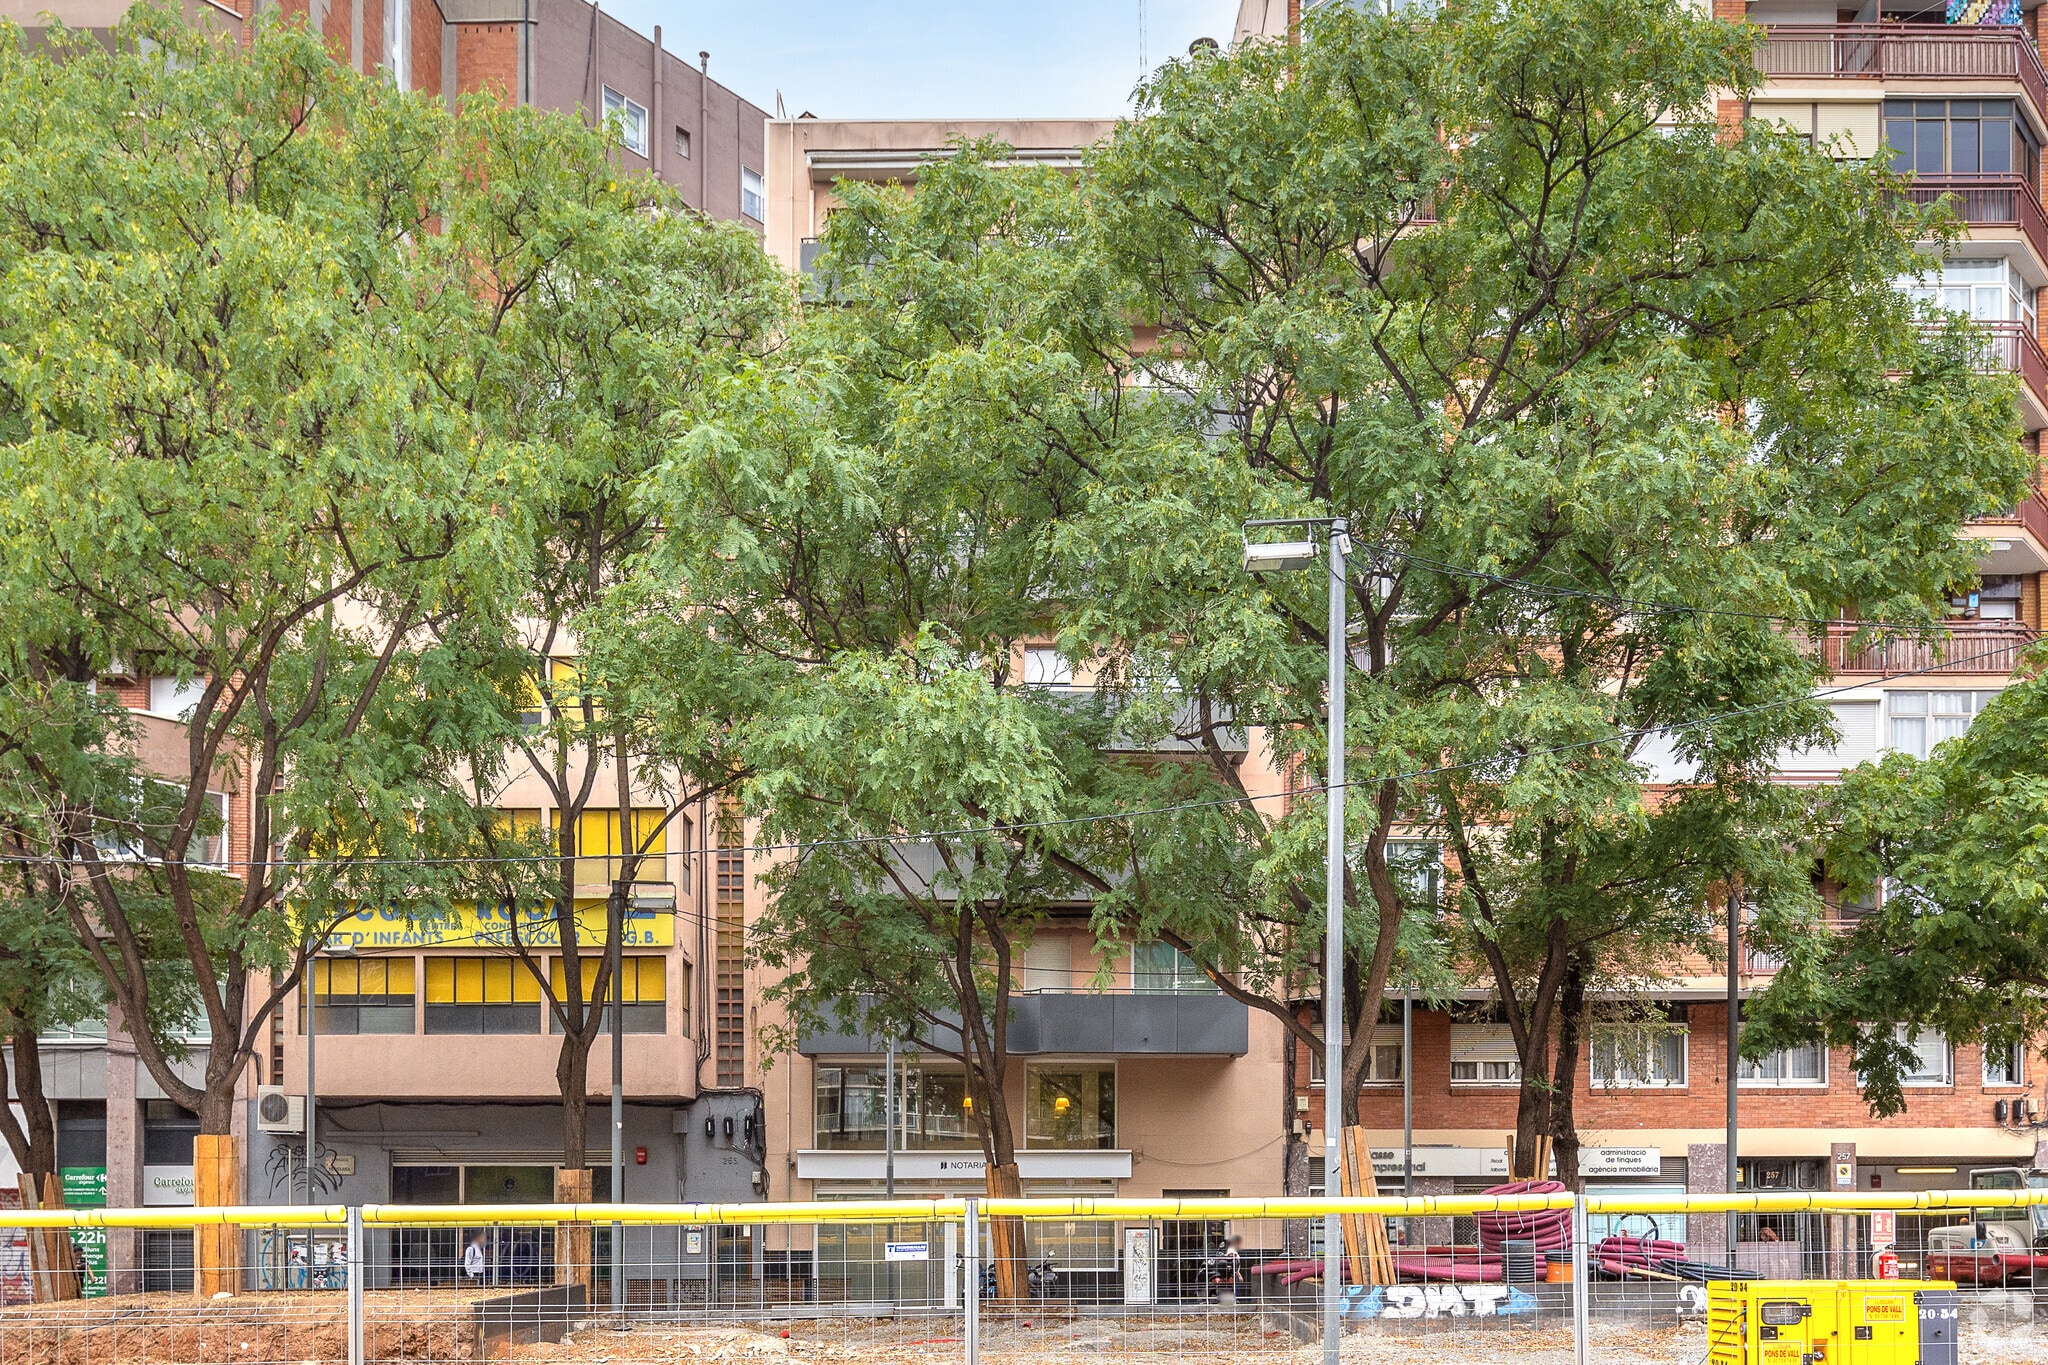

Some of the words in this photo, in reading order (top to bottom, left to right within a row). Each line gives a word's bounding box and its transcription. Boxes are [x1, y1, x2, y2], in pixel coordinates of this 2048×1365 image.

[353, 931, 444, 945] D'INFANTS
[475, 932, 580, 945] PREESCOLR
[1370, 1151, 1394, 1159] asse
[1837, 1152, 1851, 1160] 257
[1617, 1157, 1642, 1165] finques
[1588, 1165, 1618, 1174] agència
[1766, 1171, 1779, 1179] 257
[77, 1231, 106, 1244] 22h
[1881, 1305, 1889, 1313] DE
[1780, 1350, 1786, 1358] DE
